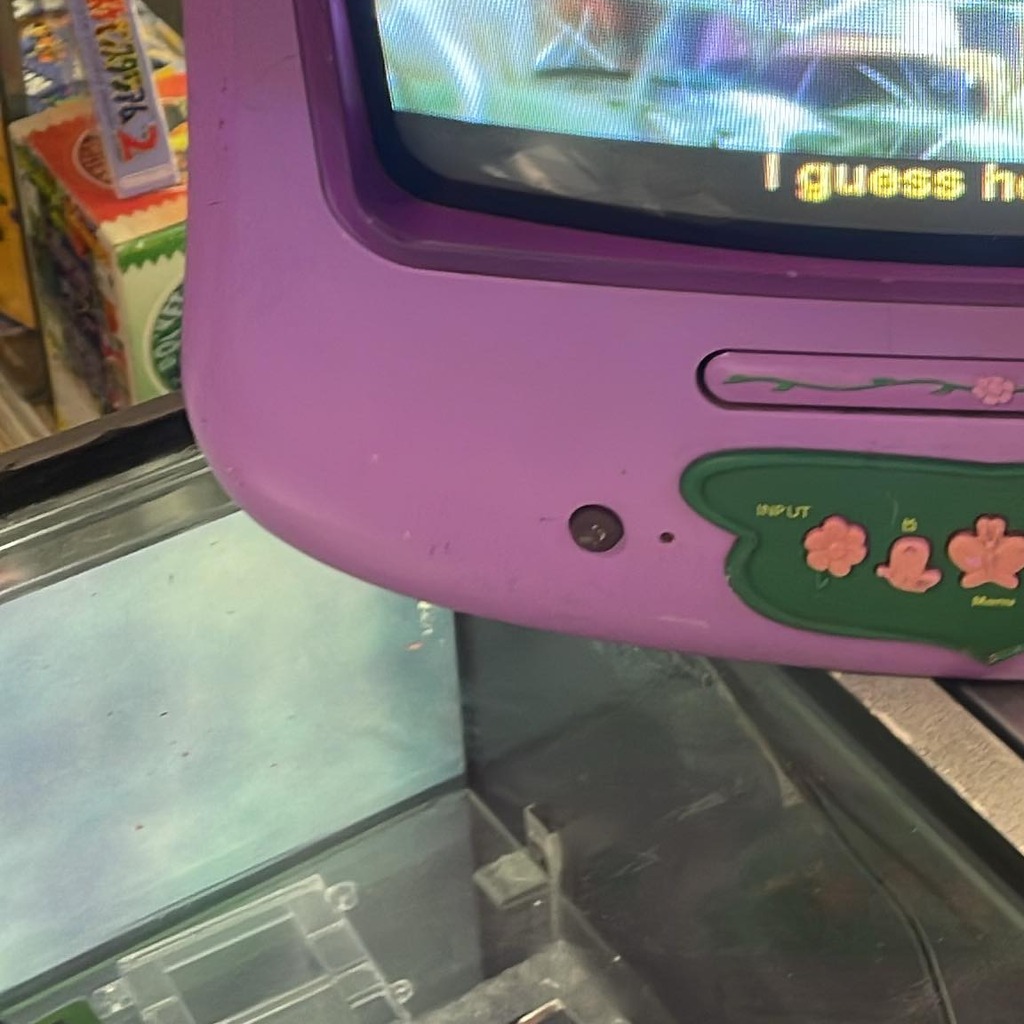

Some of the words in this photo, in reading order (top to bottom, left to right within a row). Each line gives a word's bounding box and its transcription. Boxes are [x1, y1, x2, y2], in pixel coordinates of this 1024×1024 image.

[762, 152, 781, 192] I
[795, 161, 967, 204] guess
[755, 502, 812, 520] INPUT
